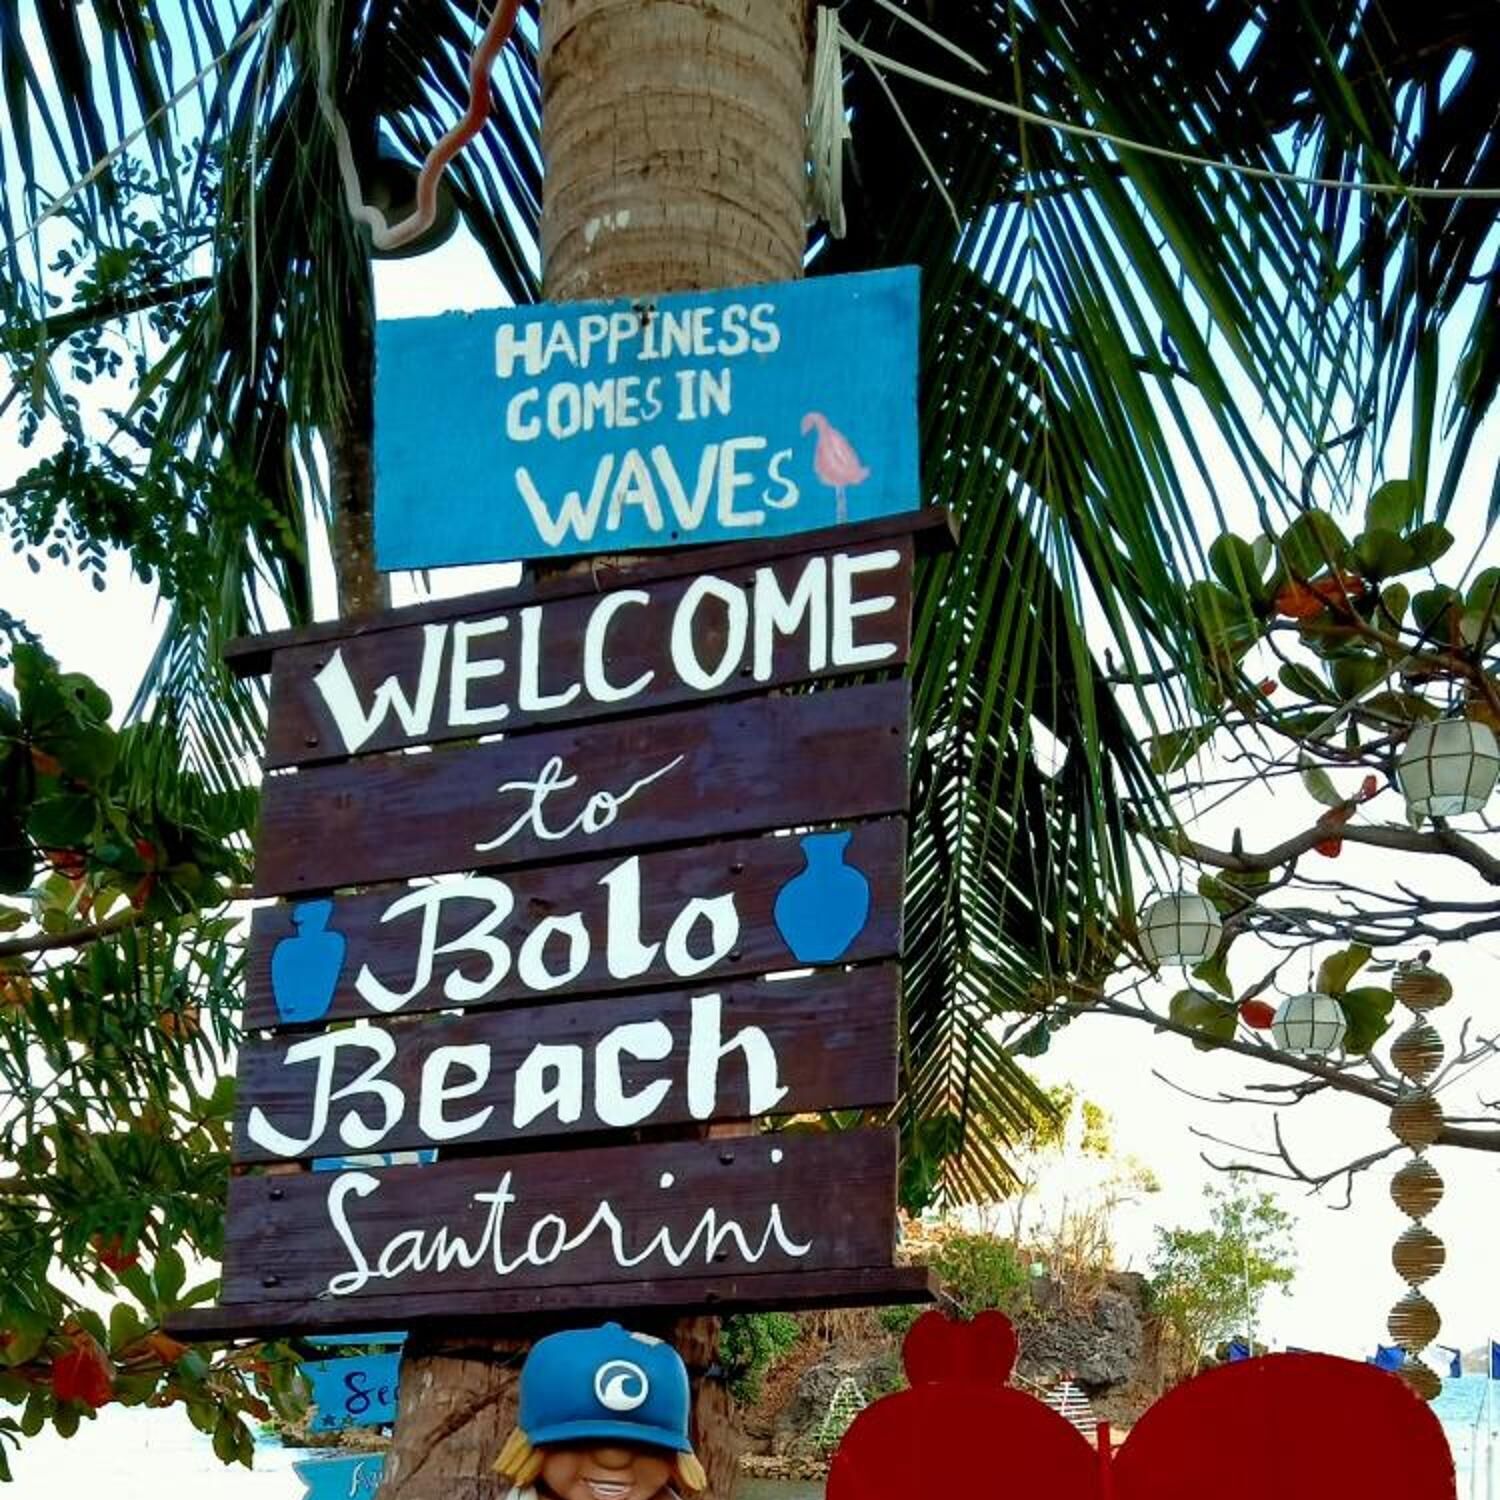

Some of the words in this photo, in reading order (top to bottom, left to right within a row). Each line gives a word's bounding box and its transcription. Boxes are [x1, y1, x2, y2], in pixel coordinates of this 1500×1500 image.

[496, 304, 780, 377] HAPPINESS
[676, 368, 731, 421] IN
[515, 436, 799, 546] WAVES
[313, 549, 900, 753] WELCOME
[475, 755, 685, 851] to
[355, 855, 739, 1012] Bolo
[247, 994, 788, 1156] Beach
[317, 1149, 811, 1299] Santorini
[344, 1371, 400, 1415] Se
